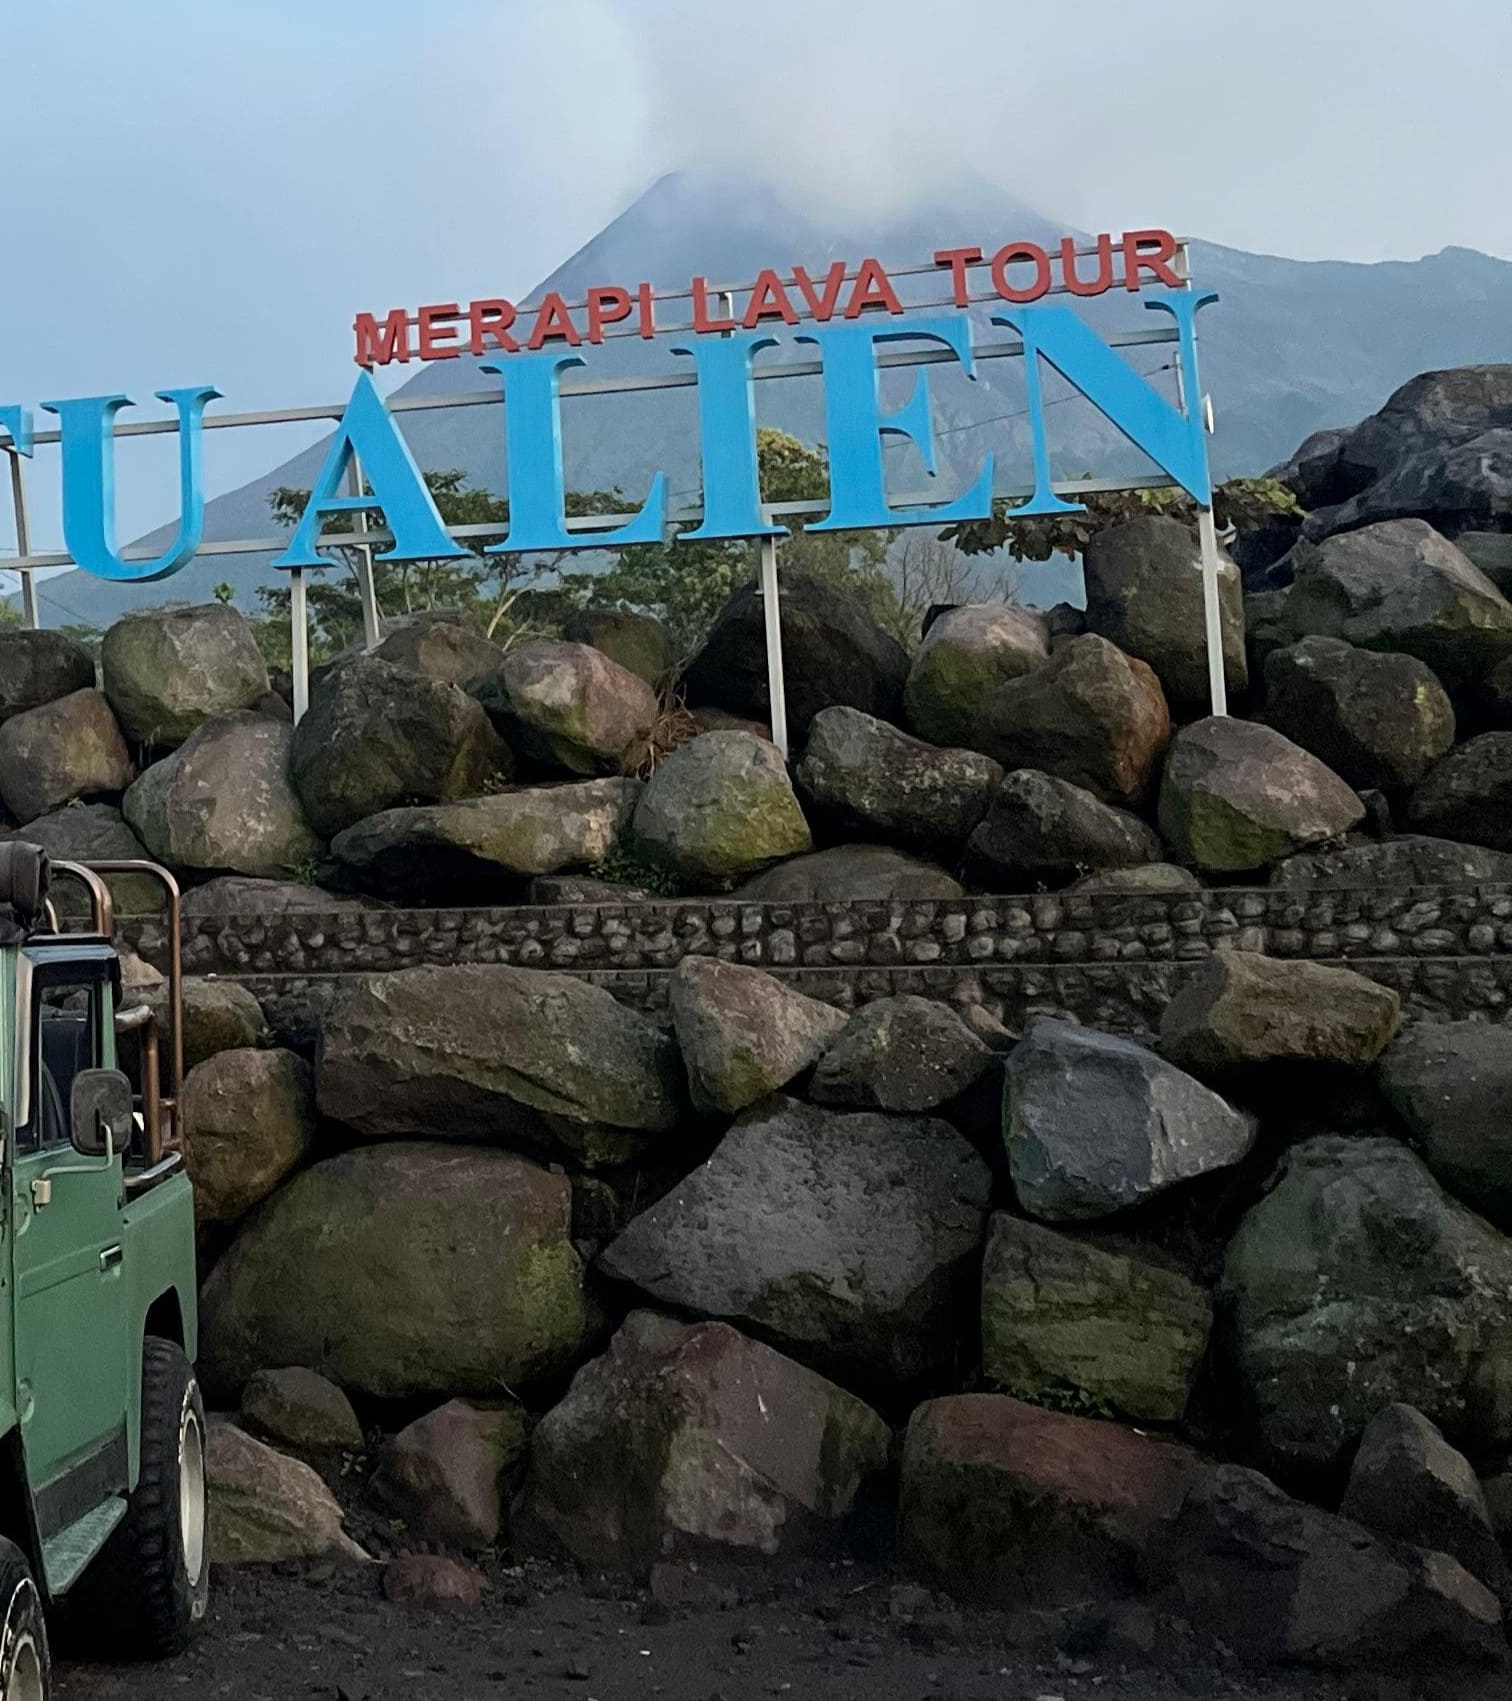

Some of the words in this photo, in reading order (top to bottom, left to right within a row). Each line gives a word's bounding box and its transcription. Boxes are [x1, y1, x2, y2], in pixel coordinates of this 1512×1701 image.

[353, 282, 656, 366] MERAPI
[692, 258, 905, 334] LAVA
[934, 229, 1188, 308] TOUR
[270, 288, 1219, 570] ALIEN
